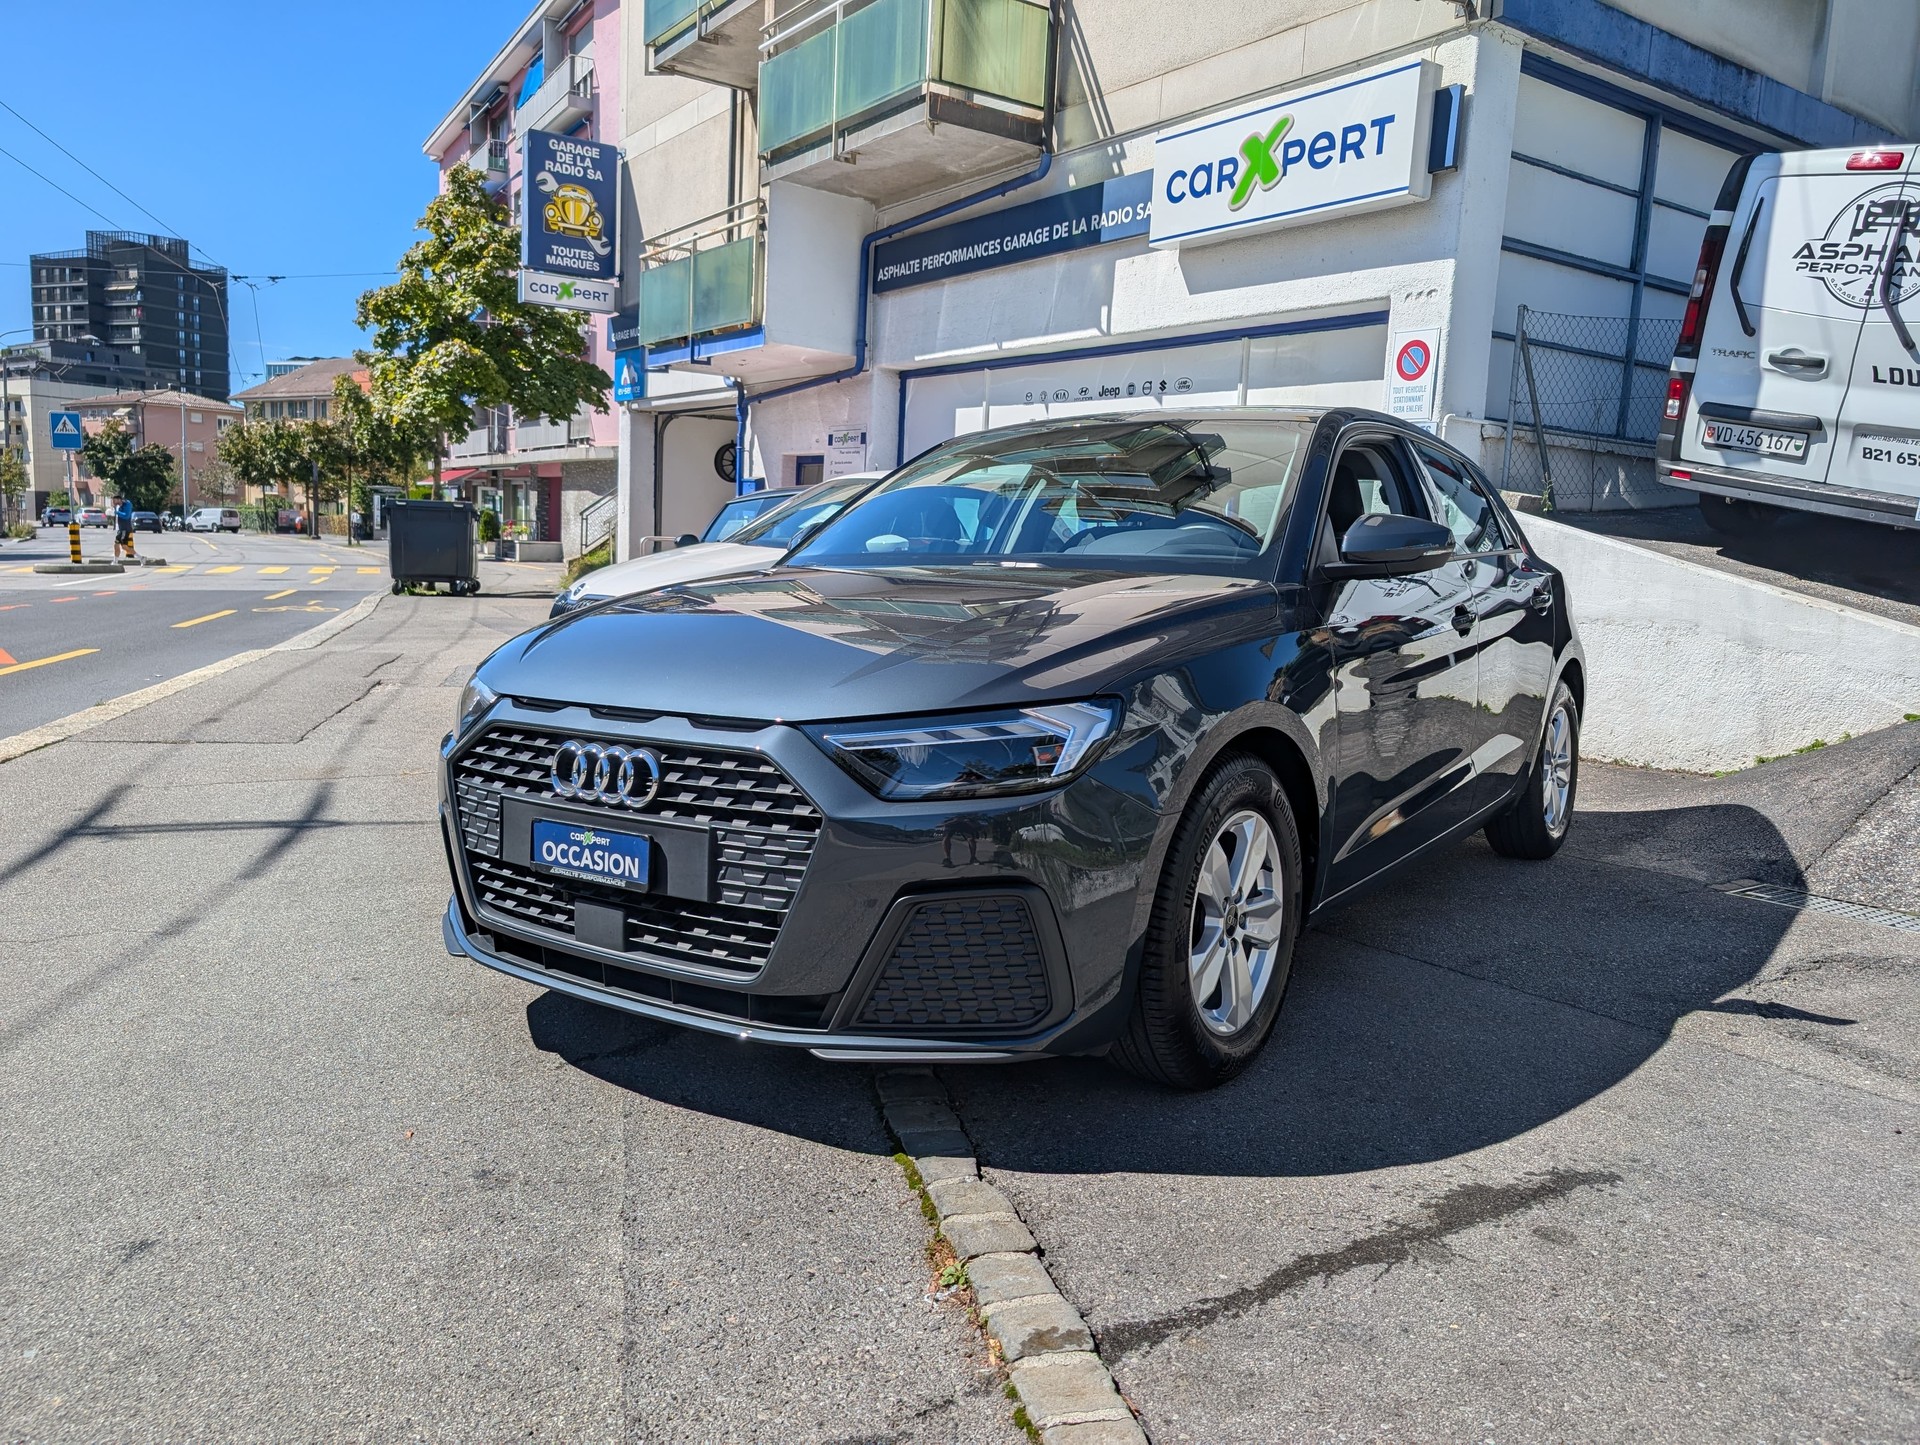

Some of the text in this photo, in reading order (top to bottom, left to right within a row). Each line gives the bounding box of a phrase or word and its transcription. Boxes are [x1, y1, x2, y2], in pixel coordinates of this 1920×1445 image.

[549, 139, 600, 159] GARAGE
[556, 151, 592, 168] DE LA
[545, 160, 603, 182] RADIO SA
[877, 200, 1152, 282] ASPHALTE PERFORMANCES GARAGE DE LA RADIO SA
[551, 245, 595, 261] TOUTES
[1791, 242, 1920, 263] ASPHA
[545, 254, 600, 272] MARQUES
[1830, 277, 1856, 300] GARAGE
[611, 329, 630, 342] GARAGE
[1711, 348, 1755, 359] TRAFIC
[1098, 385, 1120, 398] Jeep
[1405, 385, 1427, 394] VEHICULE
[1393, 395, 1424, 404] STATIONNANT
[1392, 405, 1405, 414] SERA
[1766, 433, 1794, 452] 167
[1862, 446, 1892, 463] 021
[1274, 788, 1302, 881] Continental
[542, 841, 638, 878] OCCASION
[1183, 807, 1222, 908] UltraContact
[549, 866, 627, 888] ASPHALTE PERFORMANCES
